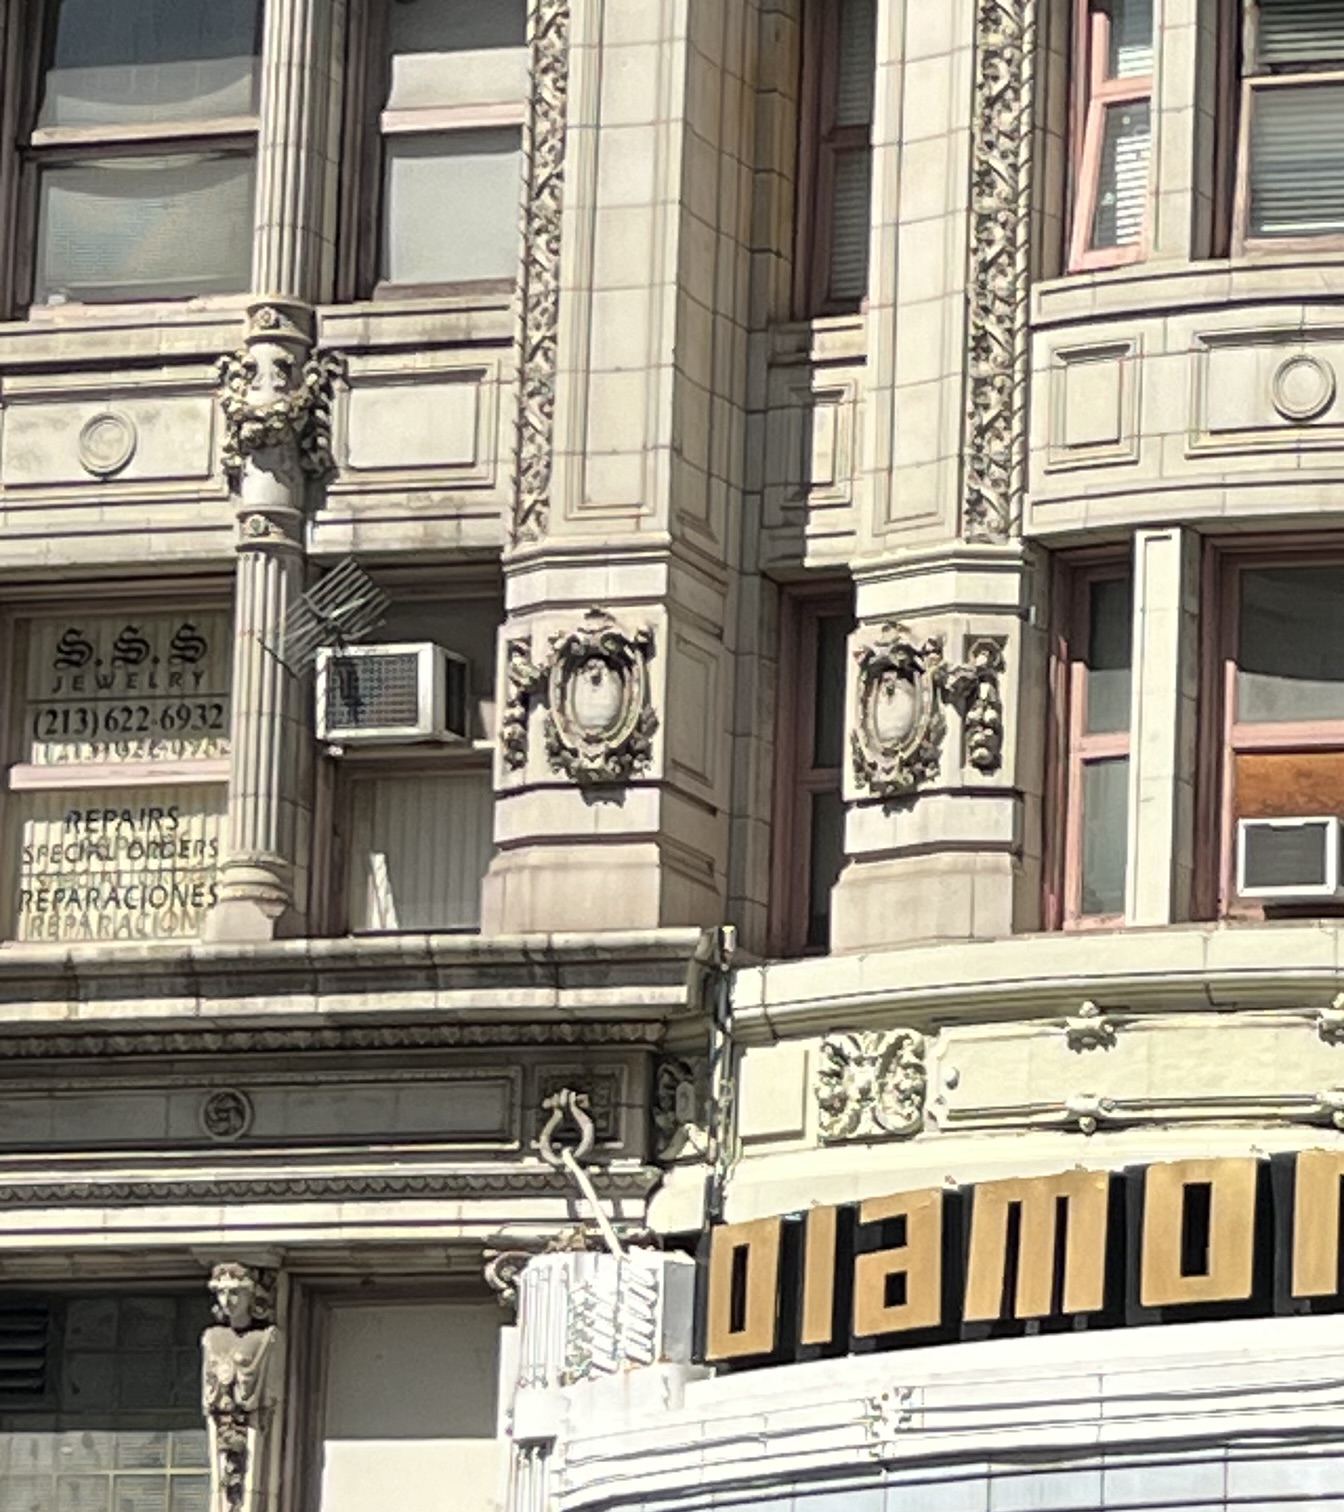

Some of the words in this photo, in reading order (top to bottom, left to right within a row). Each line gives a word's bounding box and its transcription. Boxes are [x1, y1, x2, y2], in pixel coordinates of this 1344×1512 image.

[52, 671, 205, 694] JEWELRY
[66, 806, 179, 834] REPAIRS
[23, 841, 118, 866] SPECIAL
[127, 837, 219, 861] ORDERS
[19, 882, 219, 914] REPARACIONES
